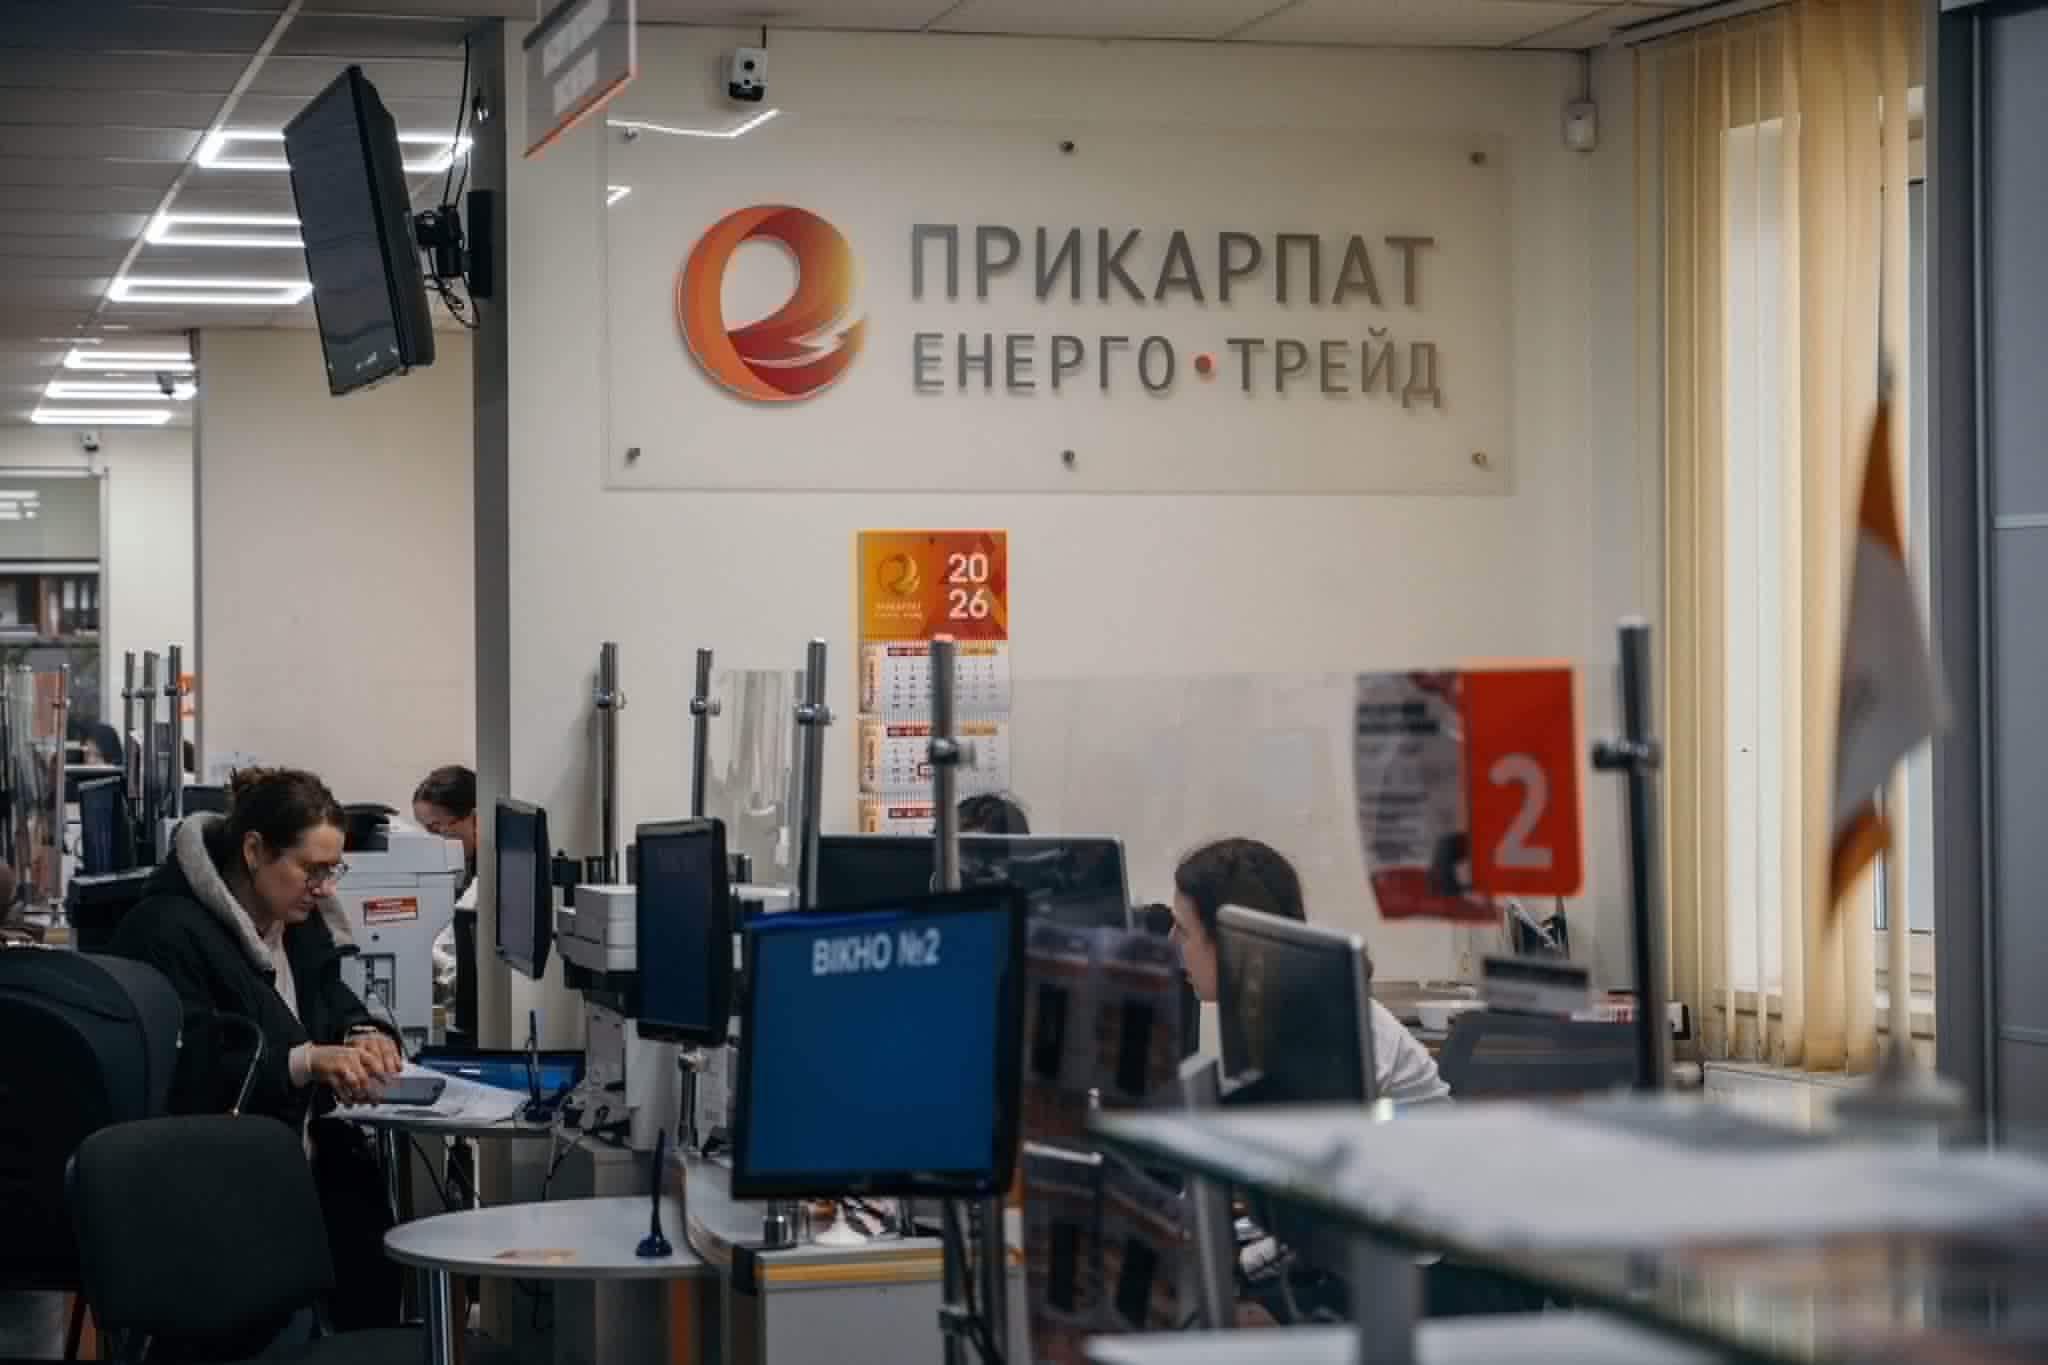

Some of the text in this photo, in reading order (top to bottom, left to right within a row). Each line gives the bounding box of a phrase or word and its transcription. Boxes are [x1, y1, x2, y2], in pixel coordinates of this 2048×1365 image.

[911, 223, 1435, 306] ПРИКАРПАТ
[949, 552, 989, 583] 20
[949, 587, 989, 619] 26
[1488, 751, 1553, 868] 2
[813, 933, 892, 976] ВІКНО
